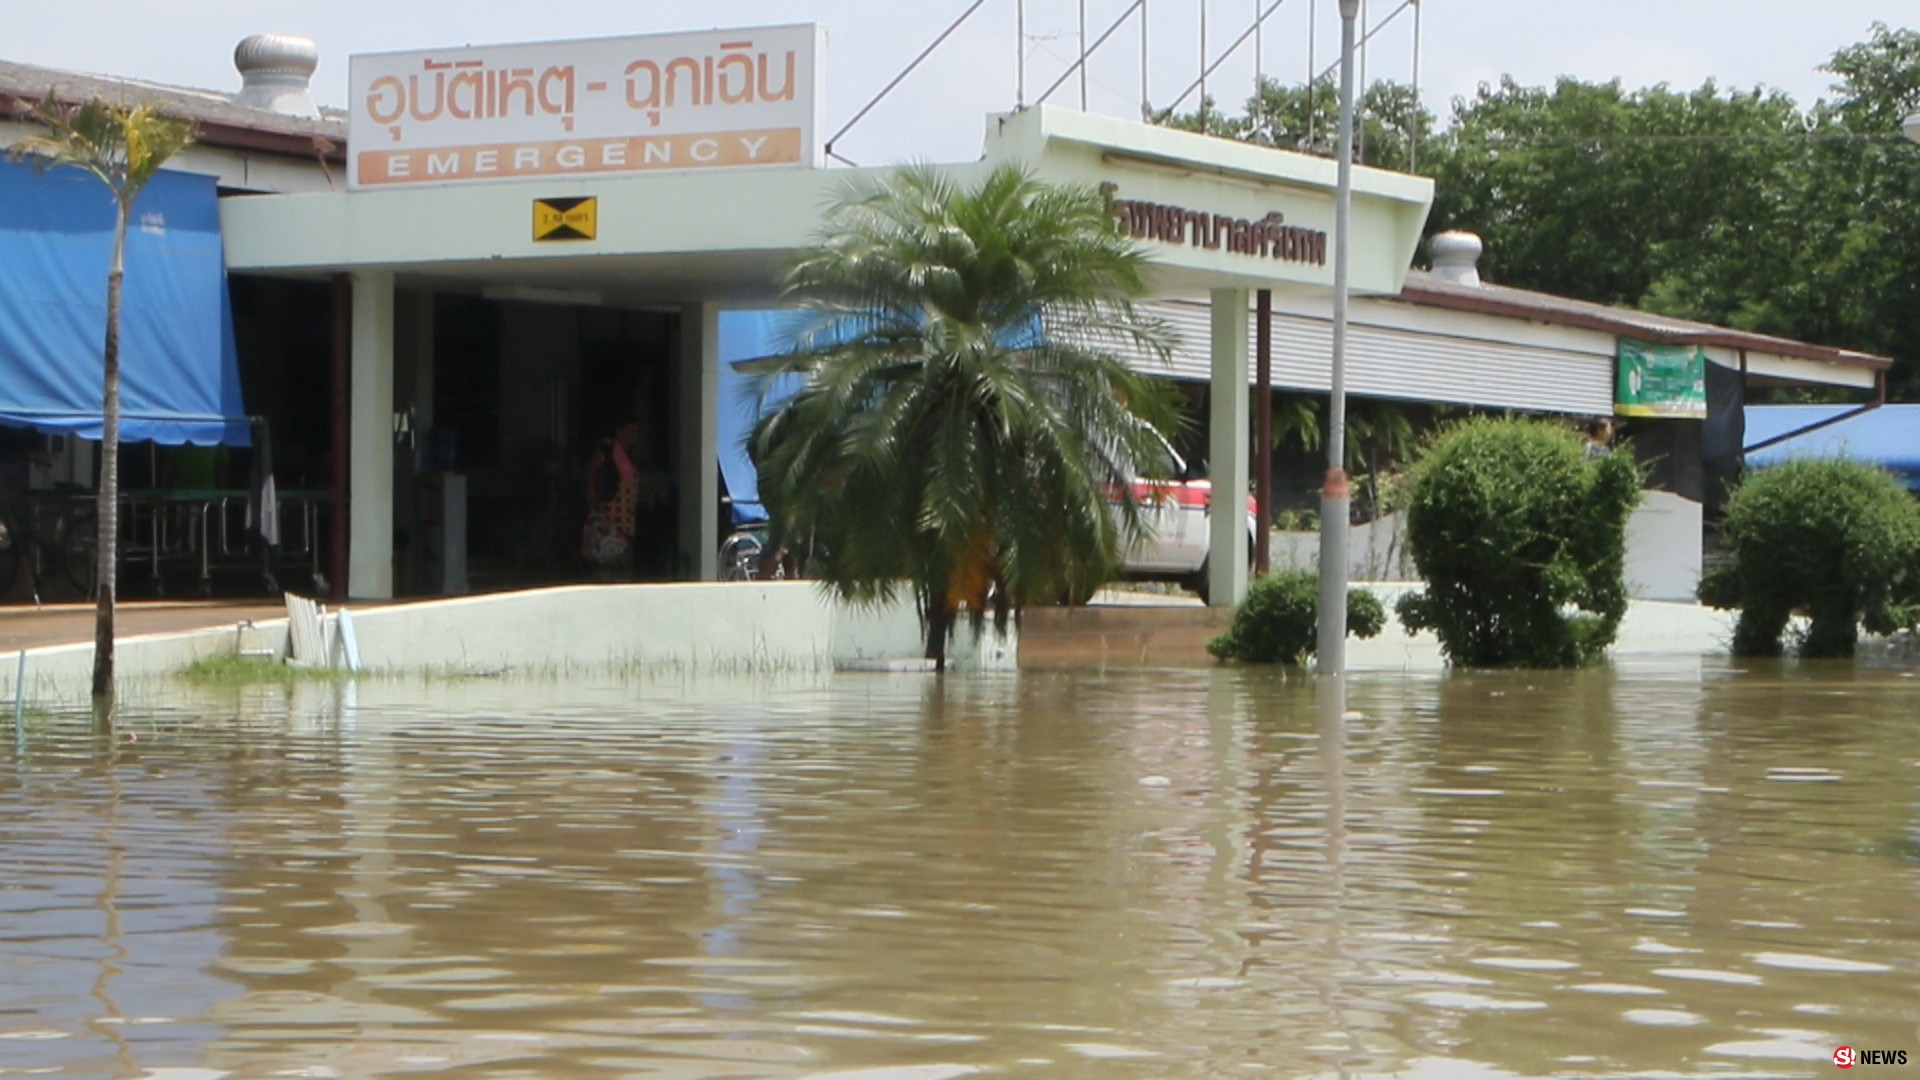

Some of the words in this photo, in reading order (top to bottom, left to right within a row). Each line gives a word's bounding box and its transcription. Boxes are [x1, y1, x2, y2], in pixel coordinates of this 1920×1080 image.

[366, 58, 574, 141] อุบัติเหตุ
[624, 41, 796, 127] ฉุกเฉิน
[387, 136, 768, 176] EMERGENCY
